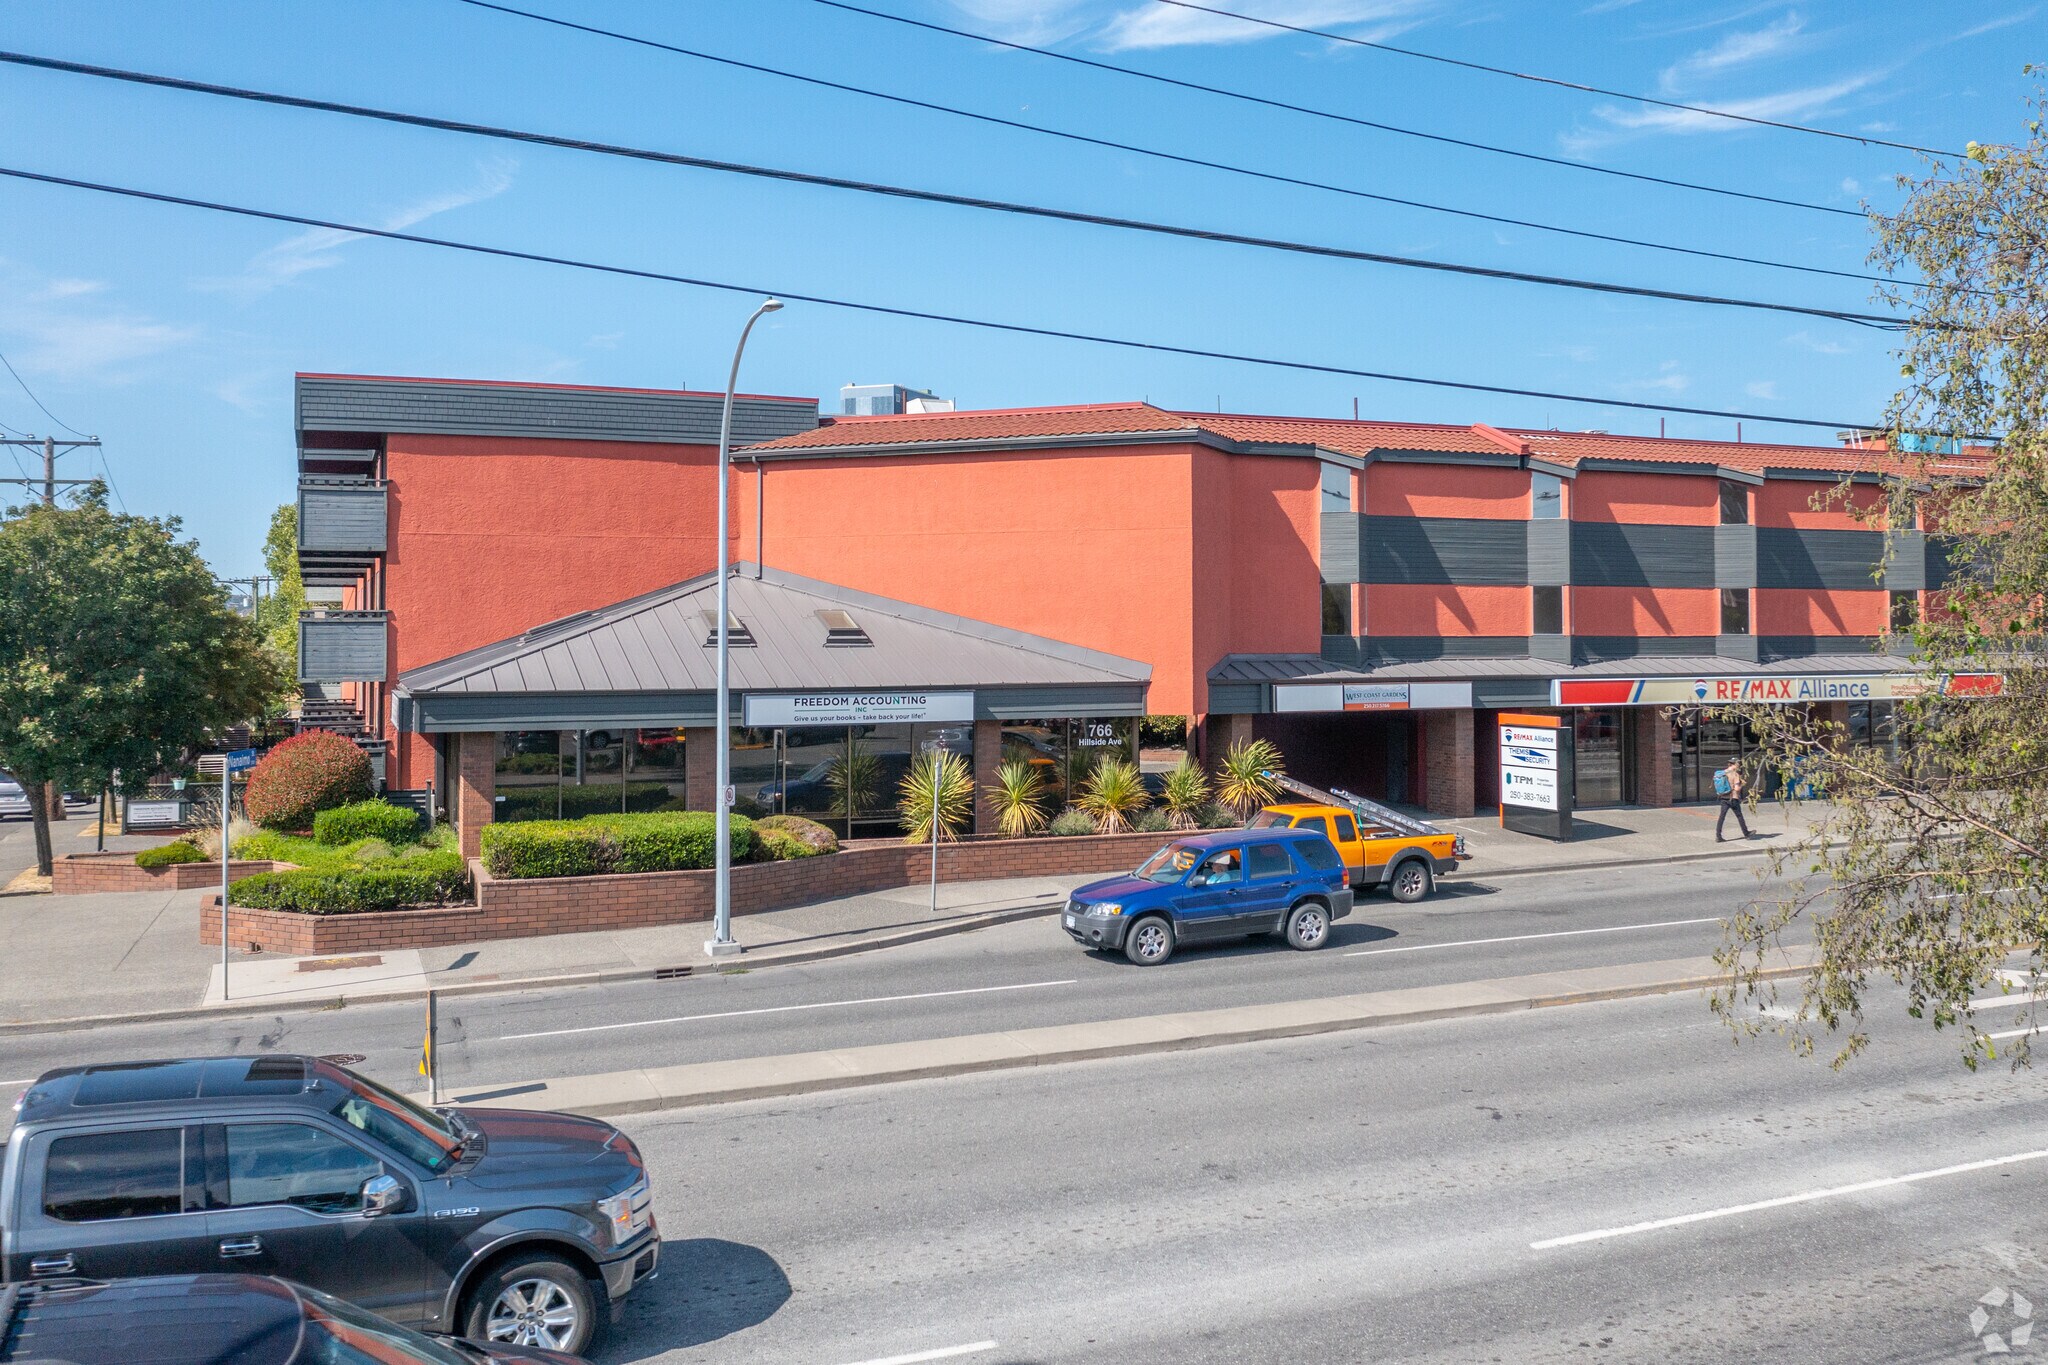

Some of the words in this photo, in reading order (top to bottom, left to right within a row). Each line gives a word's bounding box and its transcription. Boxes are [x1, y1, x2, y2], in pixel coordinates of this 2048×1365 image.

[1716, 680, 1792, 699] RE/MAX
[1799, 679, 1870, 698] Alliance
[794, 697, 849, 707] FREEDOM
[852, 695, 927, 706] ACCOUNTING
[1346, 692, 1362, 700] WEST
[1382, 691, 1408, 700] GARDENS
[1089, 724, 1113, 737] 766
[1078, 738, 1107, 746] Hillside
[1513, 733, 1533, 741] RE/MAX
[1534, 735, 1554, 744] Alliance
[1509, 748, 1529, 756] THEMIS
[229, 755, 250, 768] Nanaimo
[1525, 756, 1550, 765] SECURITY
[1513, 775, 1533, 785] TPM
[1510, 790, 1551, 803] 250-383-7663
